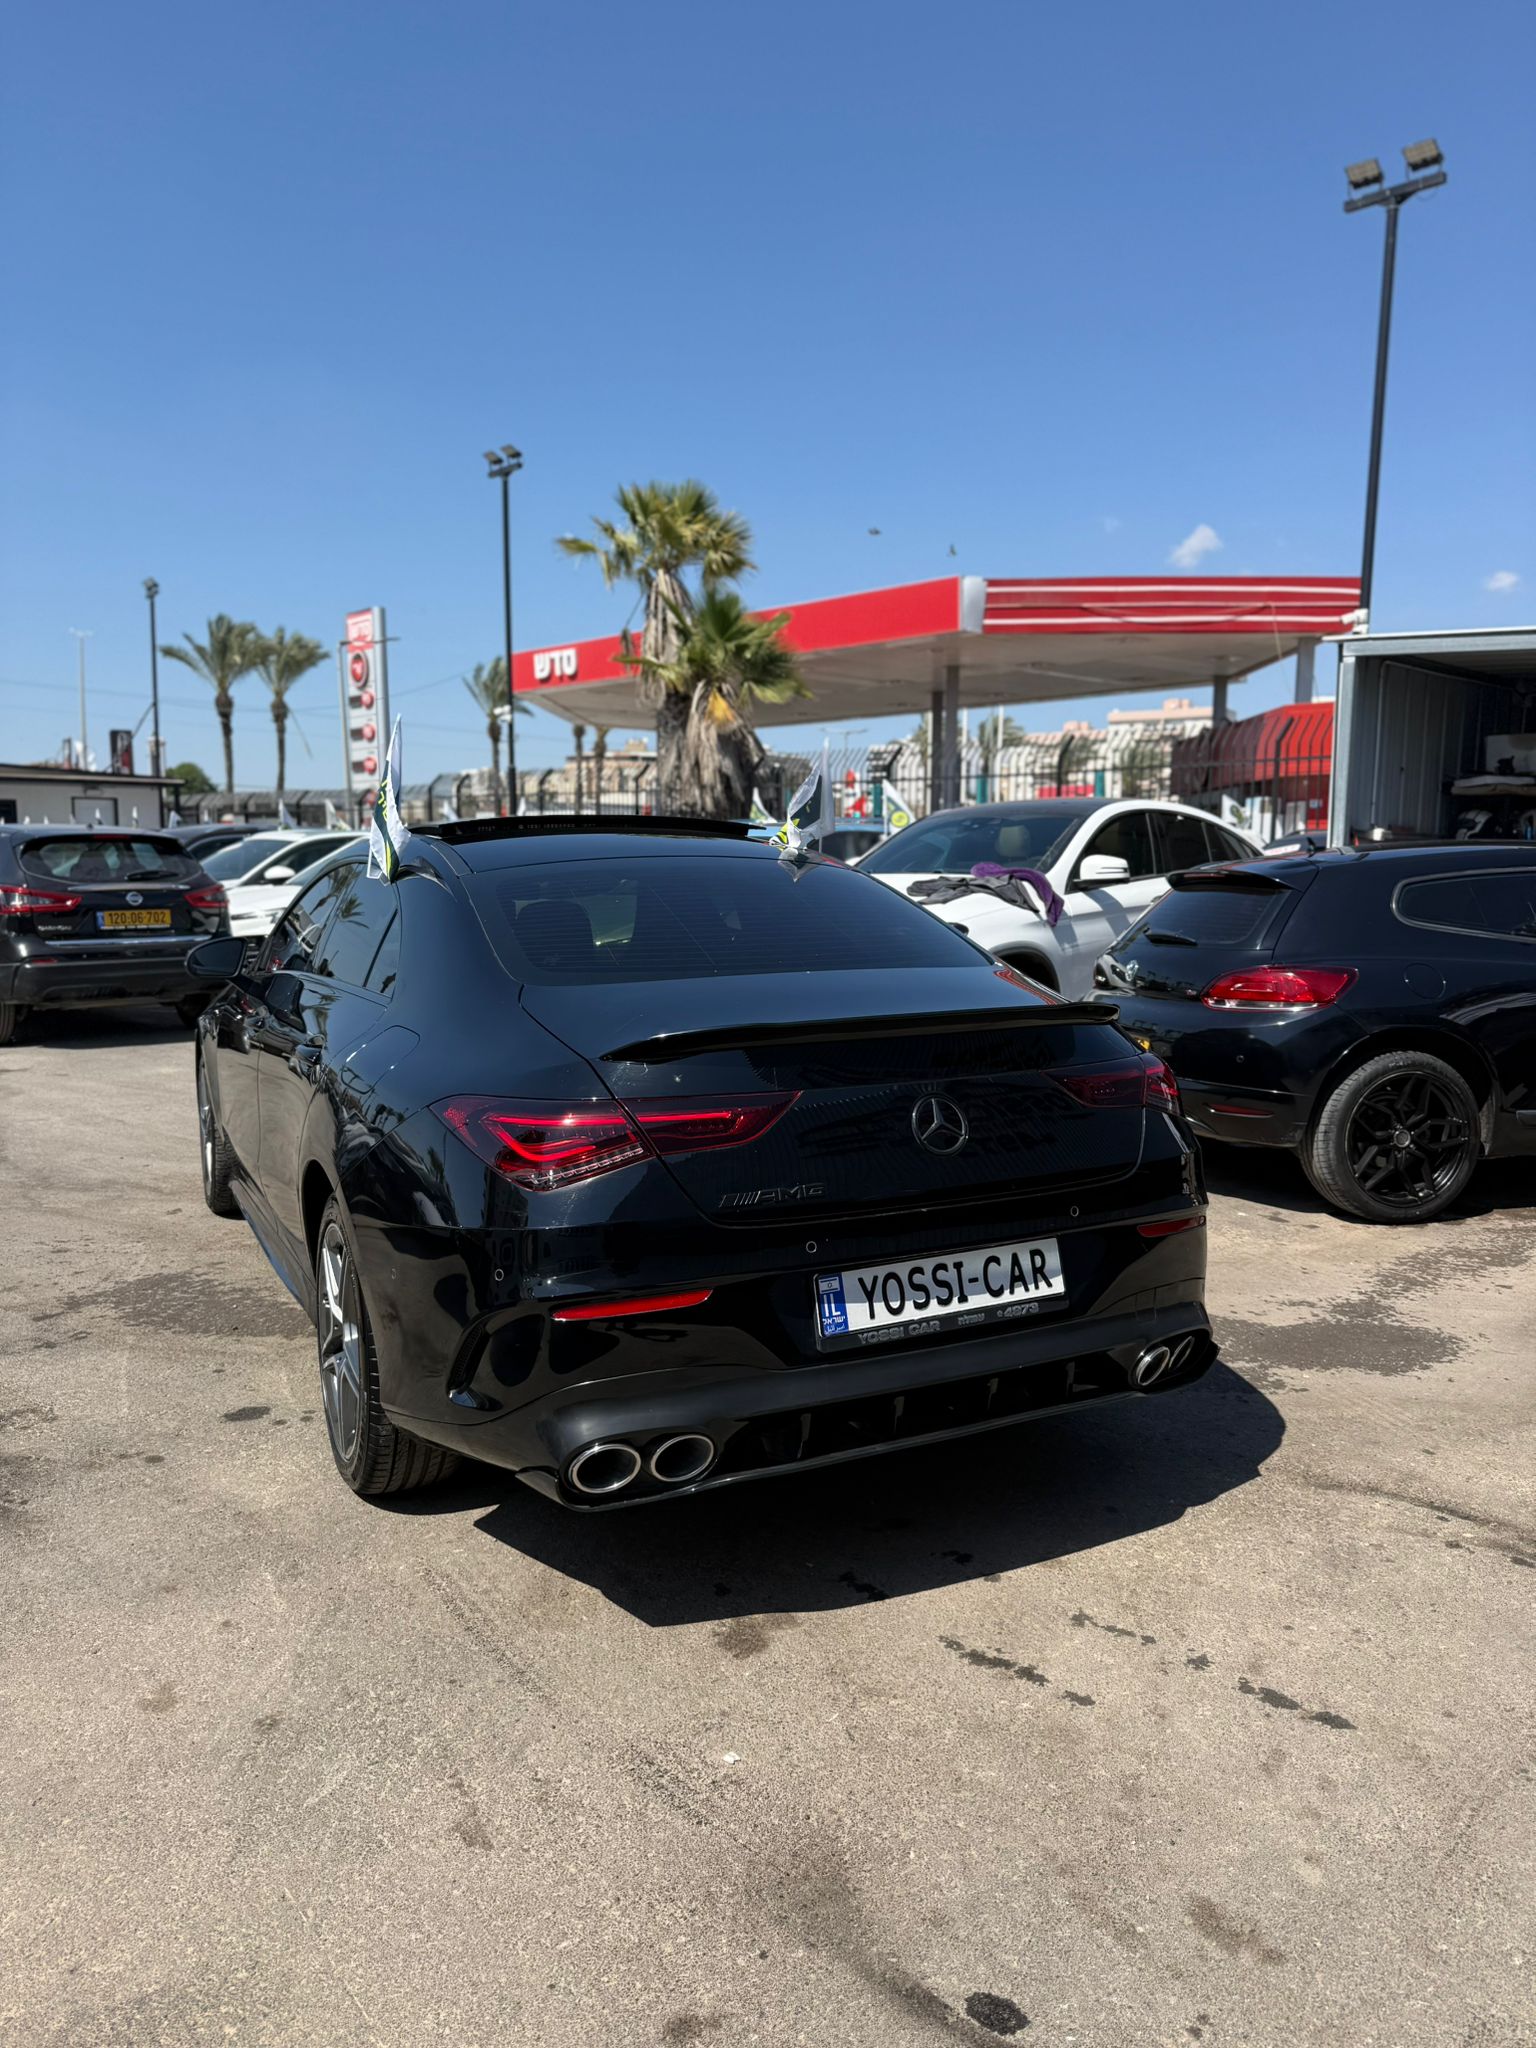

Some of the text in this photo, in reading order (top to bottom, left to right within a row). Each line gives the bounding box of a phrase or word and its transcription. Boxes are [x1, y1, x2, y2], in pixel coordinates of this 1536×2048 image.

[857, 1248, 1053, 1320] YOSSI-CAR
[823, 1293, 841, 1317] IL
[857, 1327, 905, 1345] YOSSI
[908, 1320, 941, 1336] CAR
